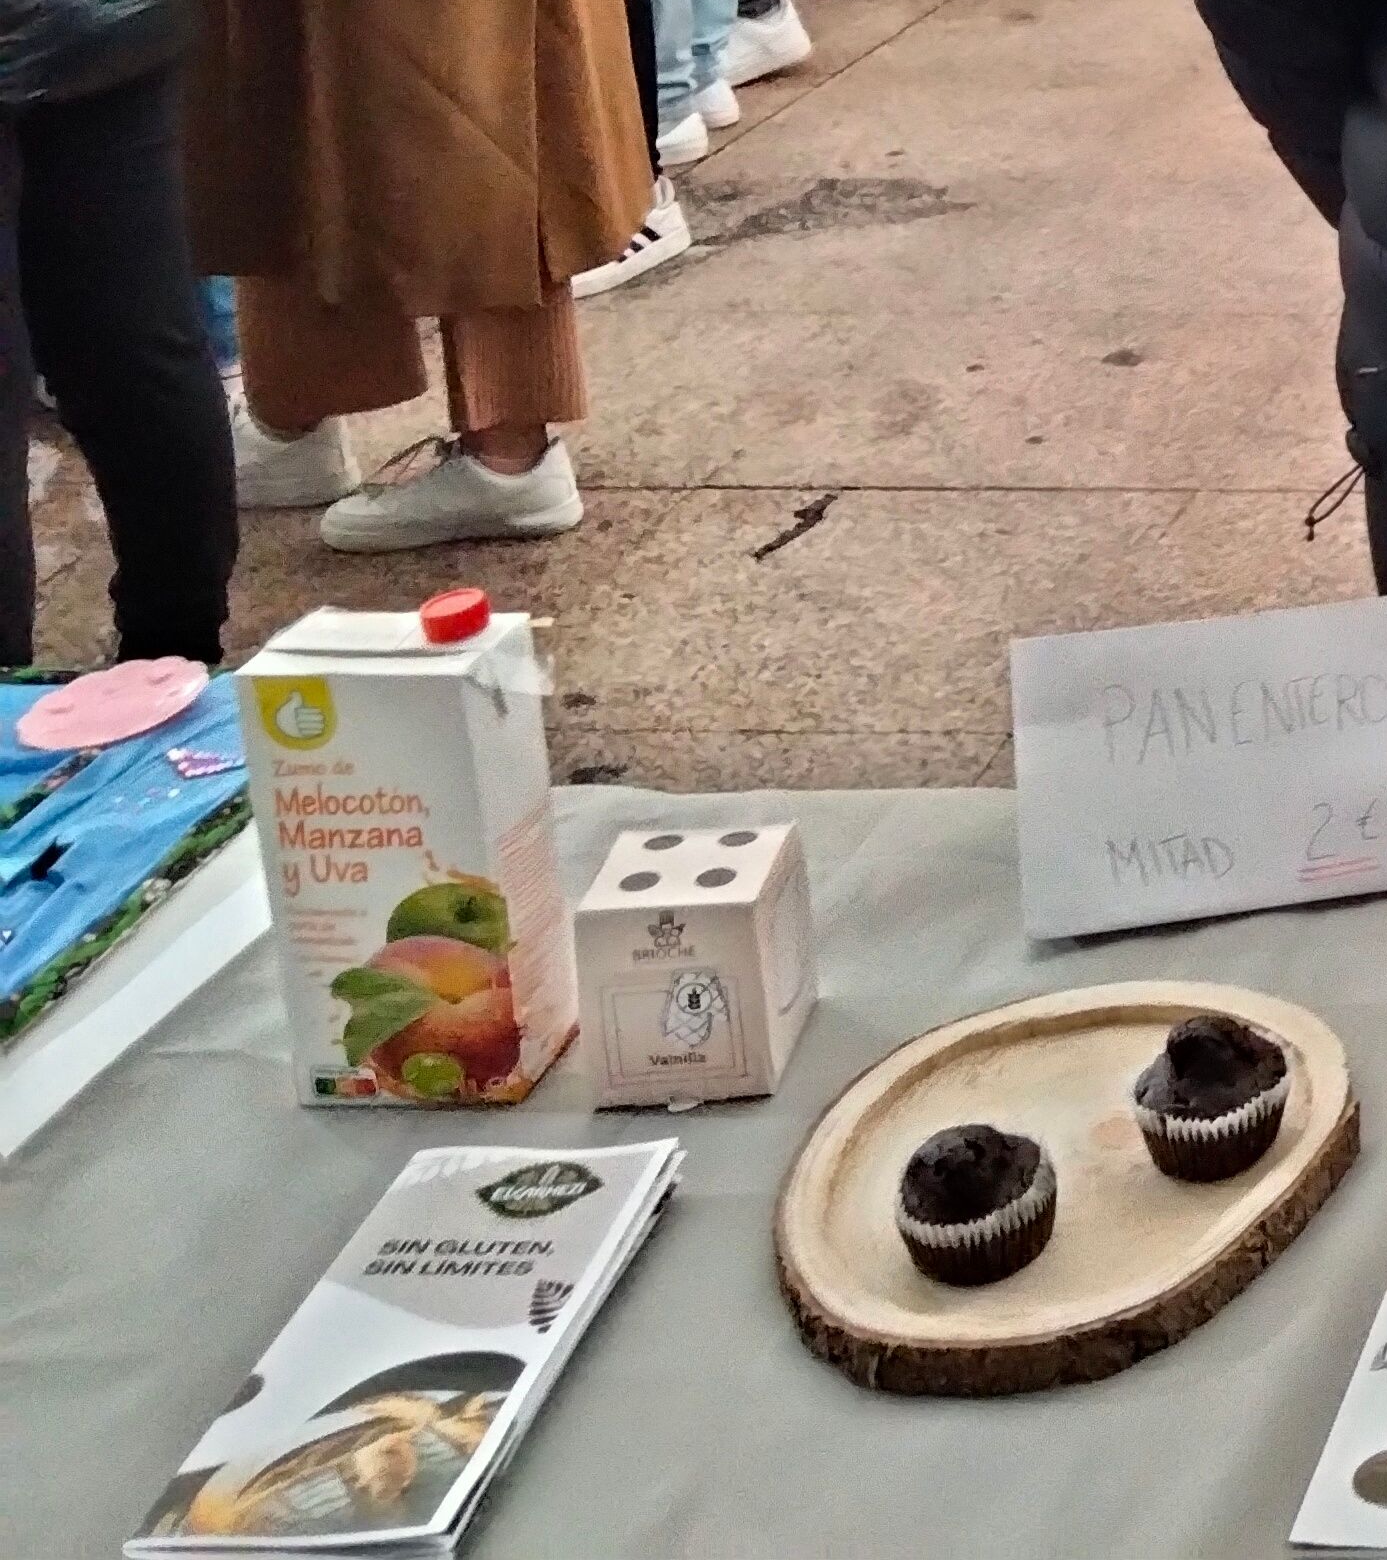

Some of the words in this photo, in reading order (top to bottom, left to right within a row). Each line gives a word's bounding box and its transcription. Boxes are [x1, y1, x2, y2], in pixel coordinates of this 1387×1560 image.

[1102, 683, 1218, 765] PAN
[331, 756, 355, 776] de
[278, 819, 424, 851] Manzana
[282, 860, 301, 898] y
[310, 853, 369, 883] Uva
[1103, 834, 1235, 888] MITAD
[377, 1239, 431, 1256] SIN
[363, 1259, 418, 1276] SIN
